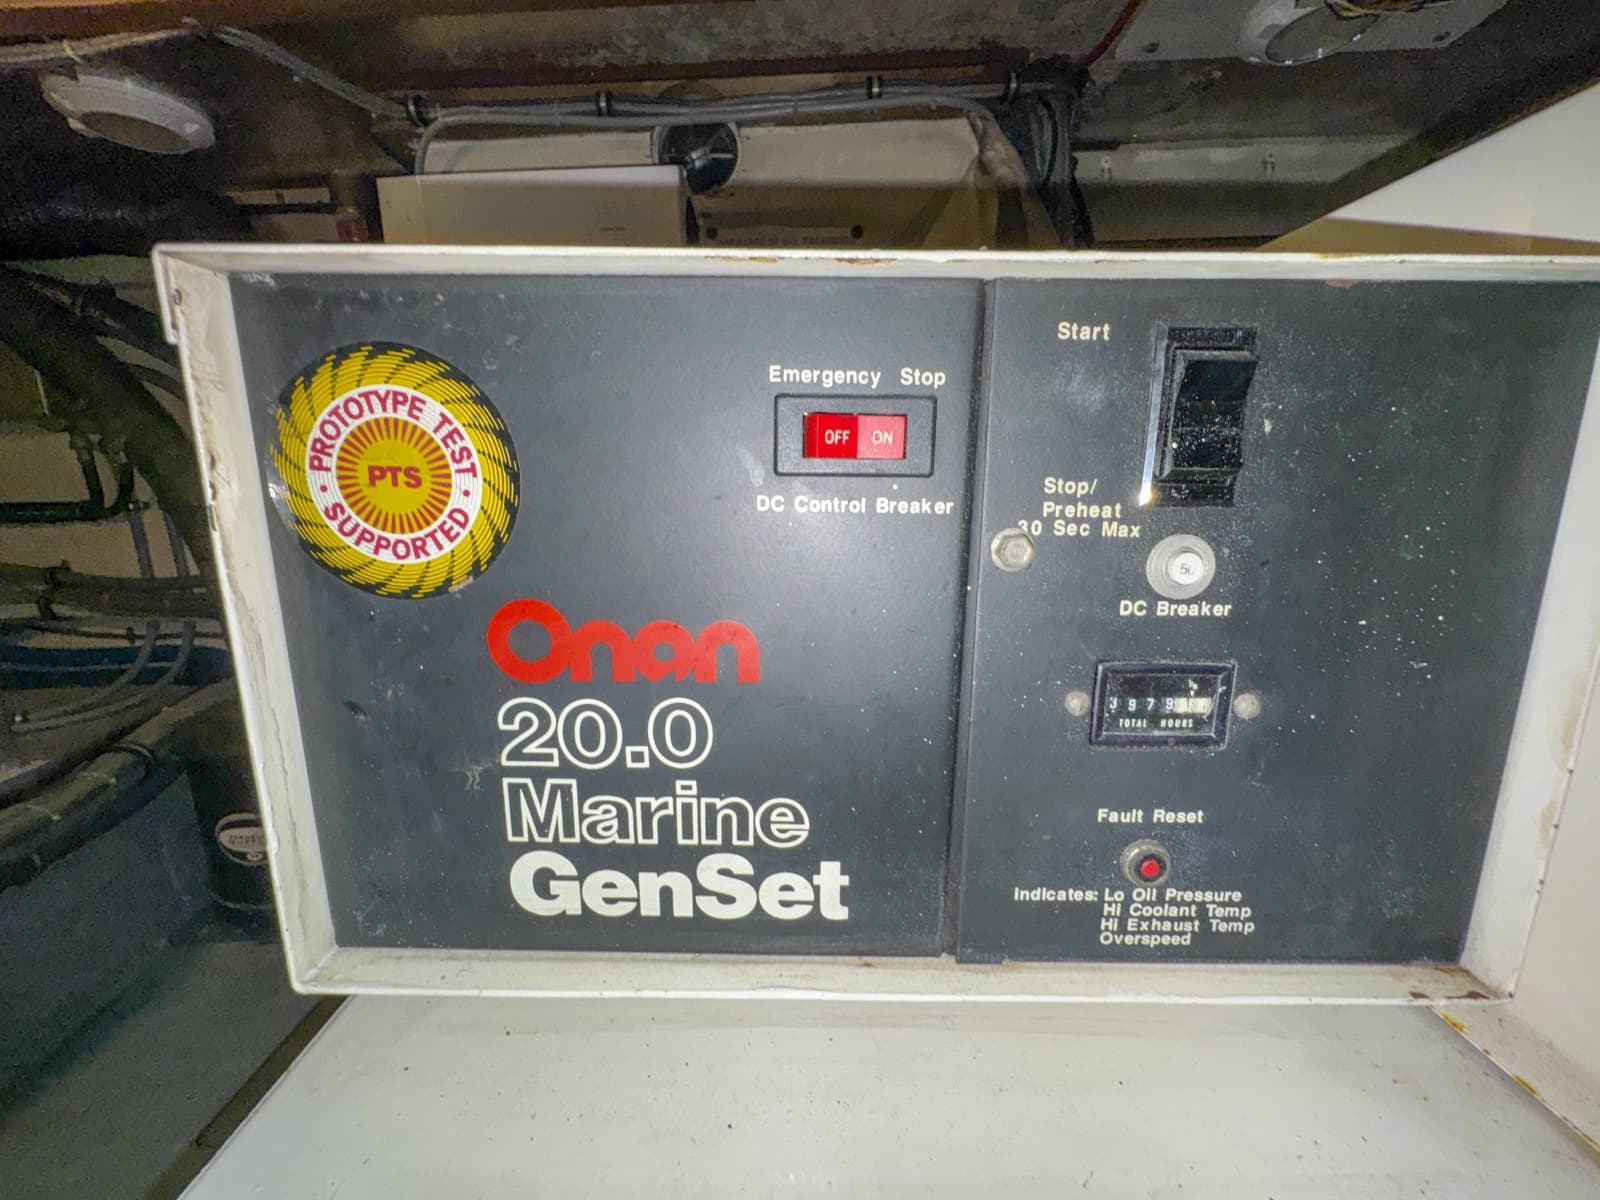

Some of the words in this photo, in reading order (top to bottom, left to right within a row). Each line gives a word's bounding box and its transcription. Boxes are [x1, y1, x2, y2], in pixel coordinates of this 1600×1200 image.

[1057, 322, 1111, 341] Start
[769, 366, 881, 388] Emergency
[900, 368, 946, 388] Stop
[309, 389, 427, 473] PROTOTYPE
[432, 412, 478, 479] TEST
[825, 429, 850, 444] OFF
[872, 430, 893, 444] ON
[367, 465, 423, 489] PTS
[1044, 477, 1097, 498] Stop/
[756, 495, 785, 512] DC
[794, 496, 866, 513] Control
[876, 497, 954, 514] Breaker
[1043, 502, 1122, 519] Preheat
[323, 502, 470, 561] SUPPORTED
[1053, 520, 1090, 536] Sec
[1101, 521, 1141, 538] Max
[1119, 601, 1147, 616] DC
[1156, 601, 1232, 616] Breaker
[486, 597, 760, 683] Onan
[1119, 719, 1147, 728] TOTAL
[1160, 719, 1193, 728] HOURS
[497, 697, 713, 769] 20.0
[502, 777, 810, 848] Marine
[1097, 809, 1144, 824] Fault
[1153, 809, 1204, 824] Reset
[510, 850, 850, 920] GenSet
[1014, 887, 1098, 902] Indicates:
[1104, 888, 1125, 902] Lo
[1132, 888, 1156, 902] Oil
[1165, 888, 1242, 902] Pressure
[1103, 903, 1121, 917] Hi
[1129, 904, 1197, 917] Coolant
[1206, 904, 1252, 919] Temp
[1100, 918, 1118, 932] Hi
[1126, 918, 1200, 932] Exhaust
[1210, 920, 1256, 934] Temp
[1099, 931, 1192, 947] Overspeed
